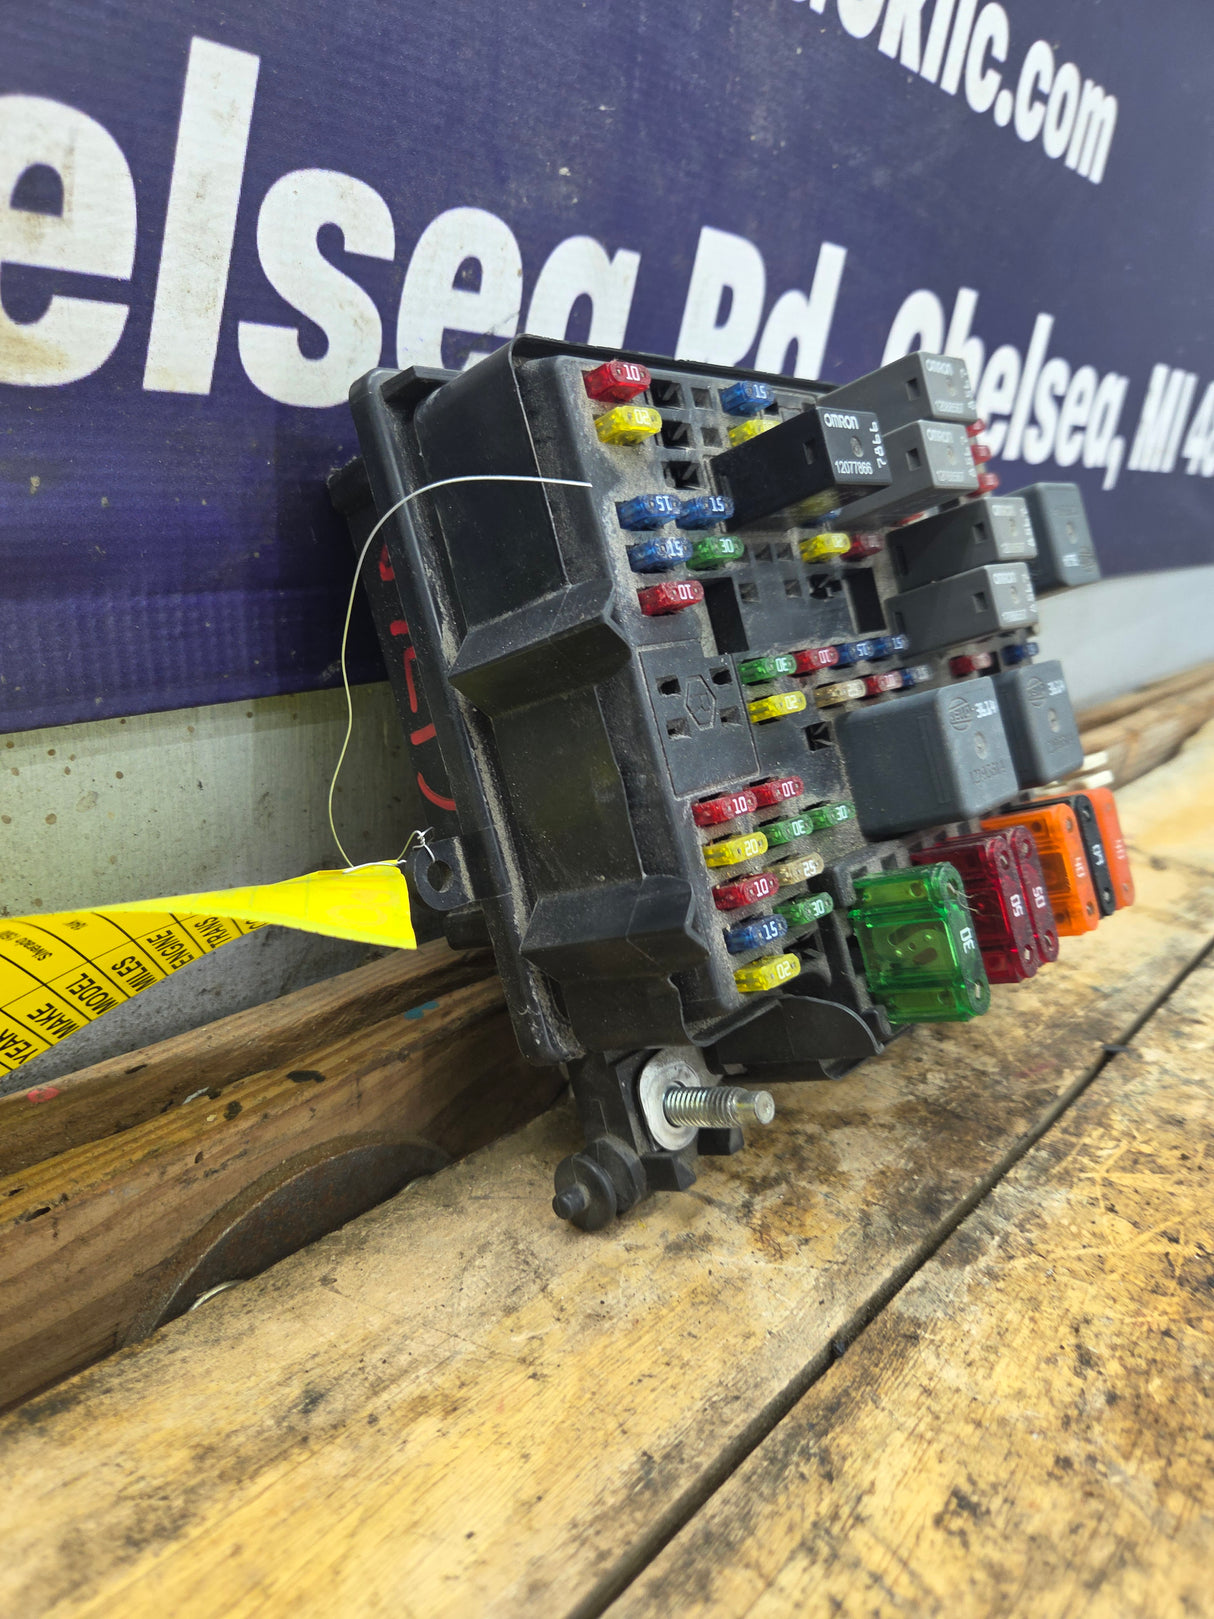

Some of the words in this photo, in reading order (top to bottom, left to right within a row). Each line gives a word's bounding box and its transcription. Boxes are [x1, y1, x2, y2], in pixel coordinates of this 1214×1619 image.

[624, 364, 641, 381] 10
[753, 384, 767, 400] 15
[634, 409, 651, 425] 20
[823, 413, 859, 429] OMRON
[1127, 362, 1198, 473] MI
[834, 460, 873, 475] 12077866
[655, 495, 673, 511] 15
[709, 496, 725, 513] 15
[666, 539, 683, 556] 15
[720, 539, 735, 553] 30
[678, 584, 693, 599] 10
[775, 658, 789, 673] 30
[818, 650, 830, 664] 10
[785, 694, 798, 710] 20
[781, 781, 796, 796] 10
[732, 797, 748, 814] 10
[834, 805, 849, 821] 30
[792, 820, 807, 836] 30
[744, 839, 759, 856] 20
[803, 861, 817, 876] 25
[753, 879, 770, 898] 10
[1010, 894, 1024, 917] 50
[1032, 886, 1046, 909] 50
[811, 900, 826, 916] 30
[194, 916, 233, 949] TRANS
[763, 922, 779, 940] 15
[959, 926, 975, 954] 30
[146, 929, 195, 970] ENGINE
[111, 955, 158, 992] MILES
[775, 962, 791, 980] 20
[65, 972, 119, 1015] MODEL
[26, 1002, 81, 1039] MAKE
